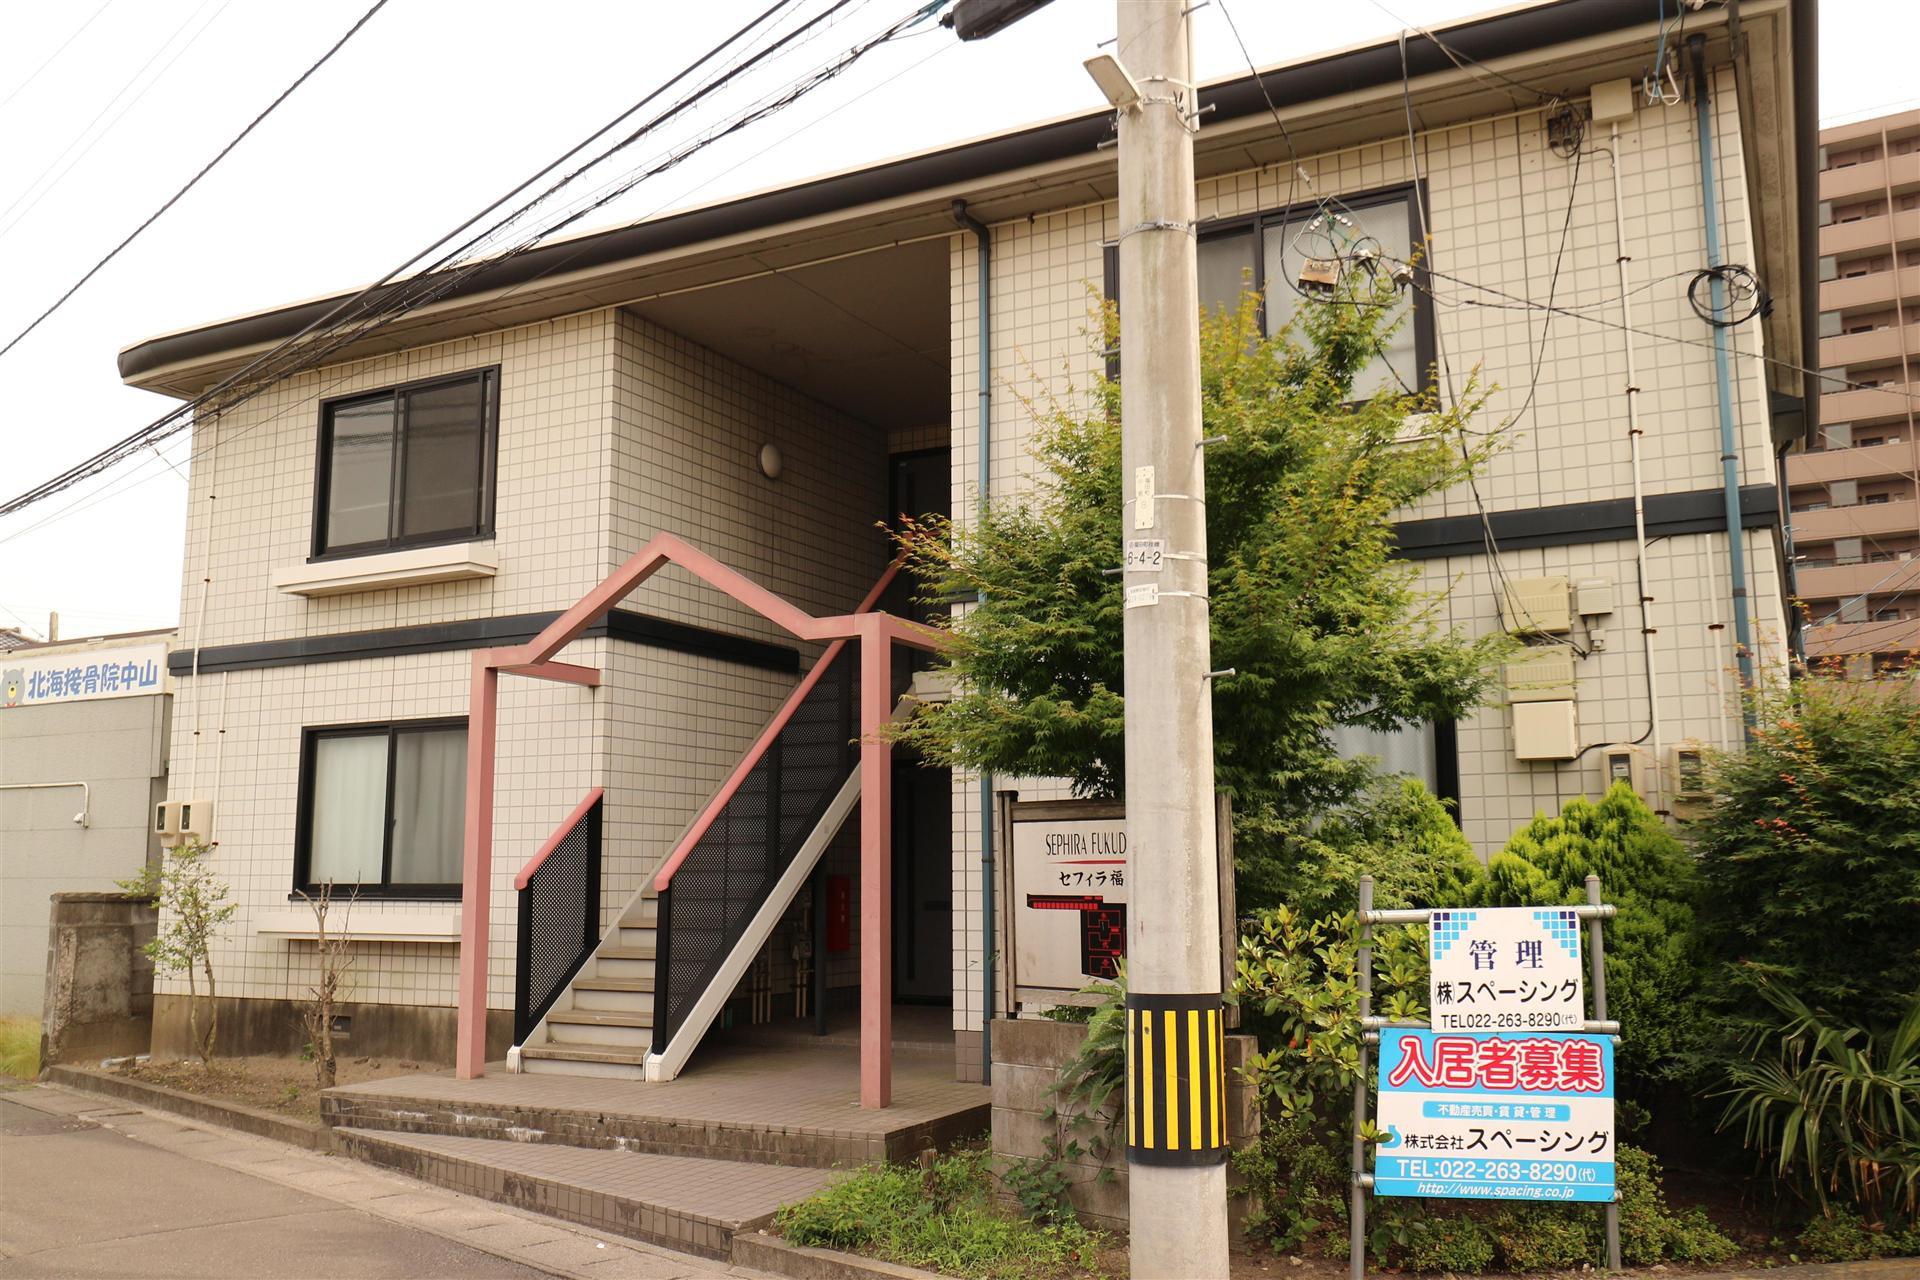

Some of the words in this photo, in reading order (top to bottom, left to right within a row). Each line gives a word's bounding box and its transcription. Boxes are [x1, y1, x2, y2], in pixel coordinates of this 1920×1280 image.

[1127, 551, 1161, 566] 6-4-2
[28, 659, 158, 699] 北海接骨院中山
[1045, 833, 1087, 856] SEPHIRA
[1059, 870, 1124, 887] セフィラ福
[1469, 939, 1544, 970] 管理
[1389, 1035, 1605, 1092] 入居者募集
[1417, 1182, 1575, 1200] http://www.spacing.co.jp
